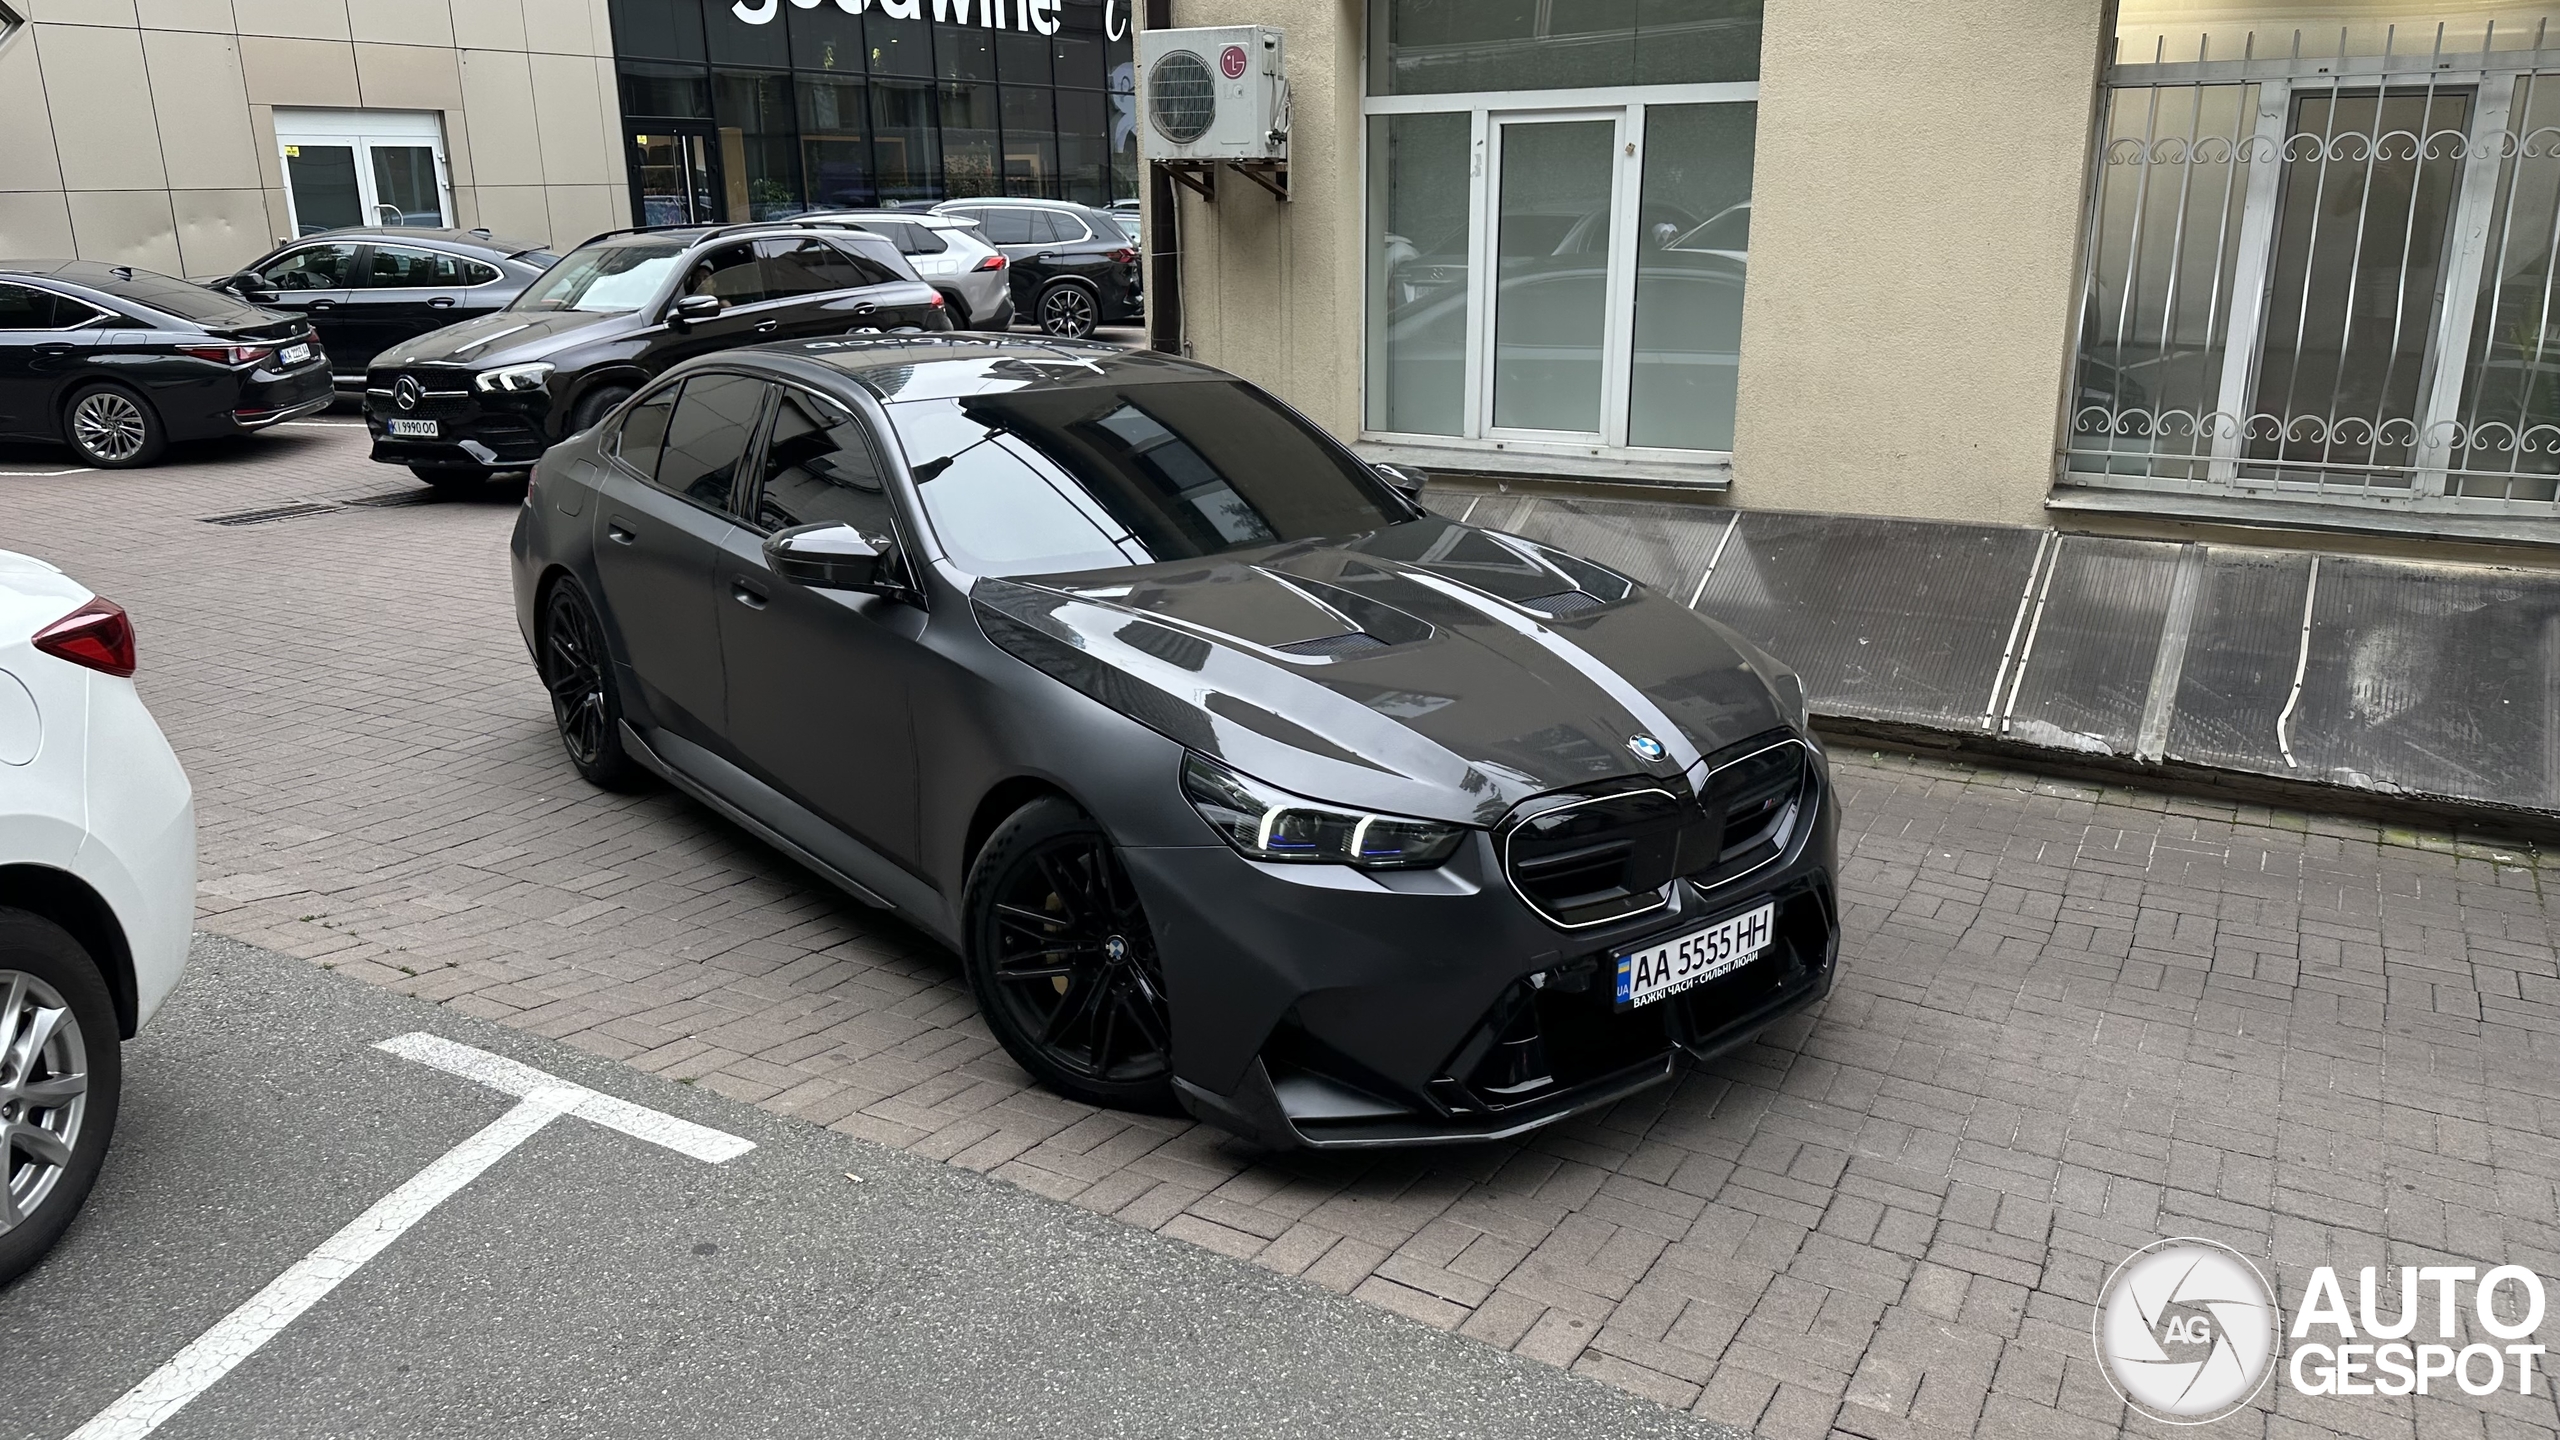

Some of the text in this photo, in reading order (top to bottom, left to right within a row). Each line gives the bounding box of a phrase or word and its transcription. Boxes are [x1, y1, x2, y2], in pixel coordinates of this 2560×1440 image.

[402, 421, 421, 433] 9990
[1633, 910, 1768, 993] AA 5555 HH
[1617, 985, 1629, 997] UA
[1633, 991, 1666, 1009] ВАЖКІ
[1668, 979, 1693, 996] ЧАСИ
[1699, 963, 1731, 984] СИЛЬНІ
[1732, 951, 1759, 972] ЛЮДИ
